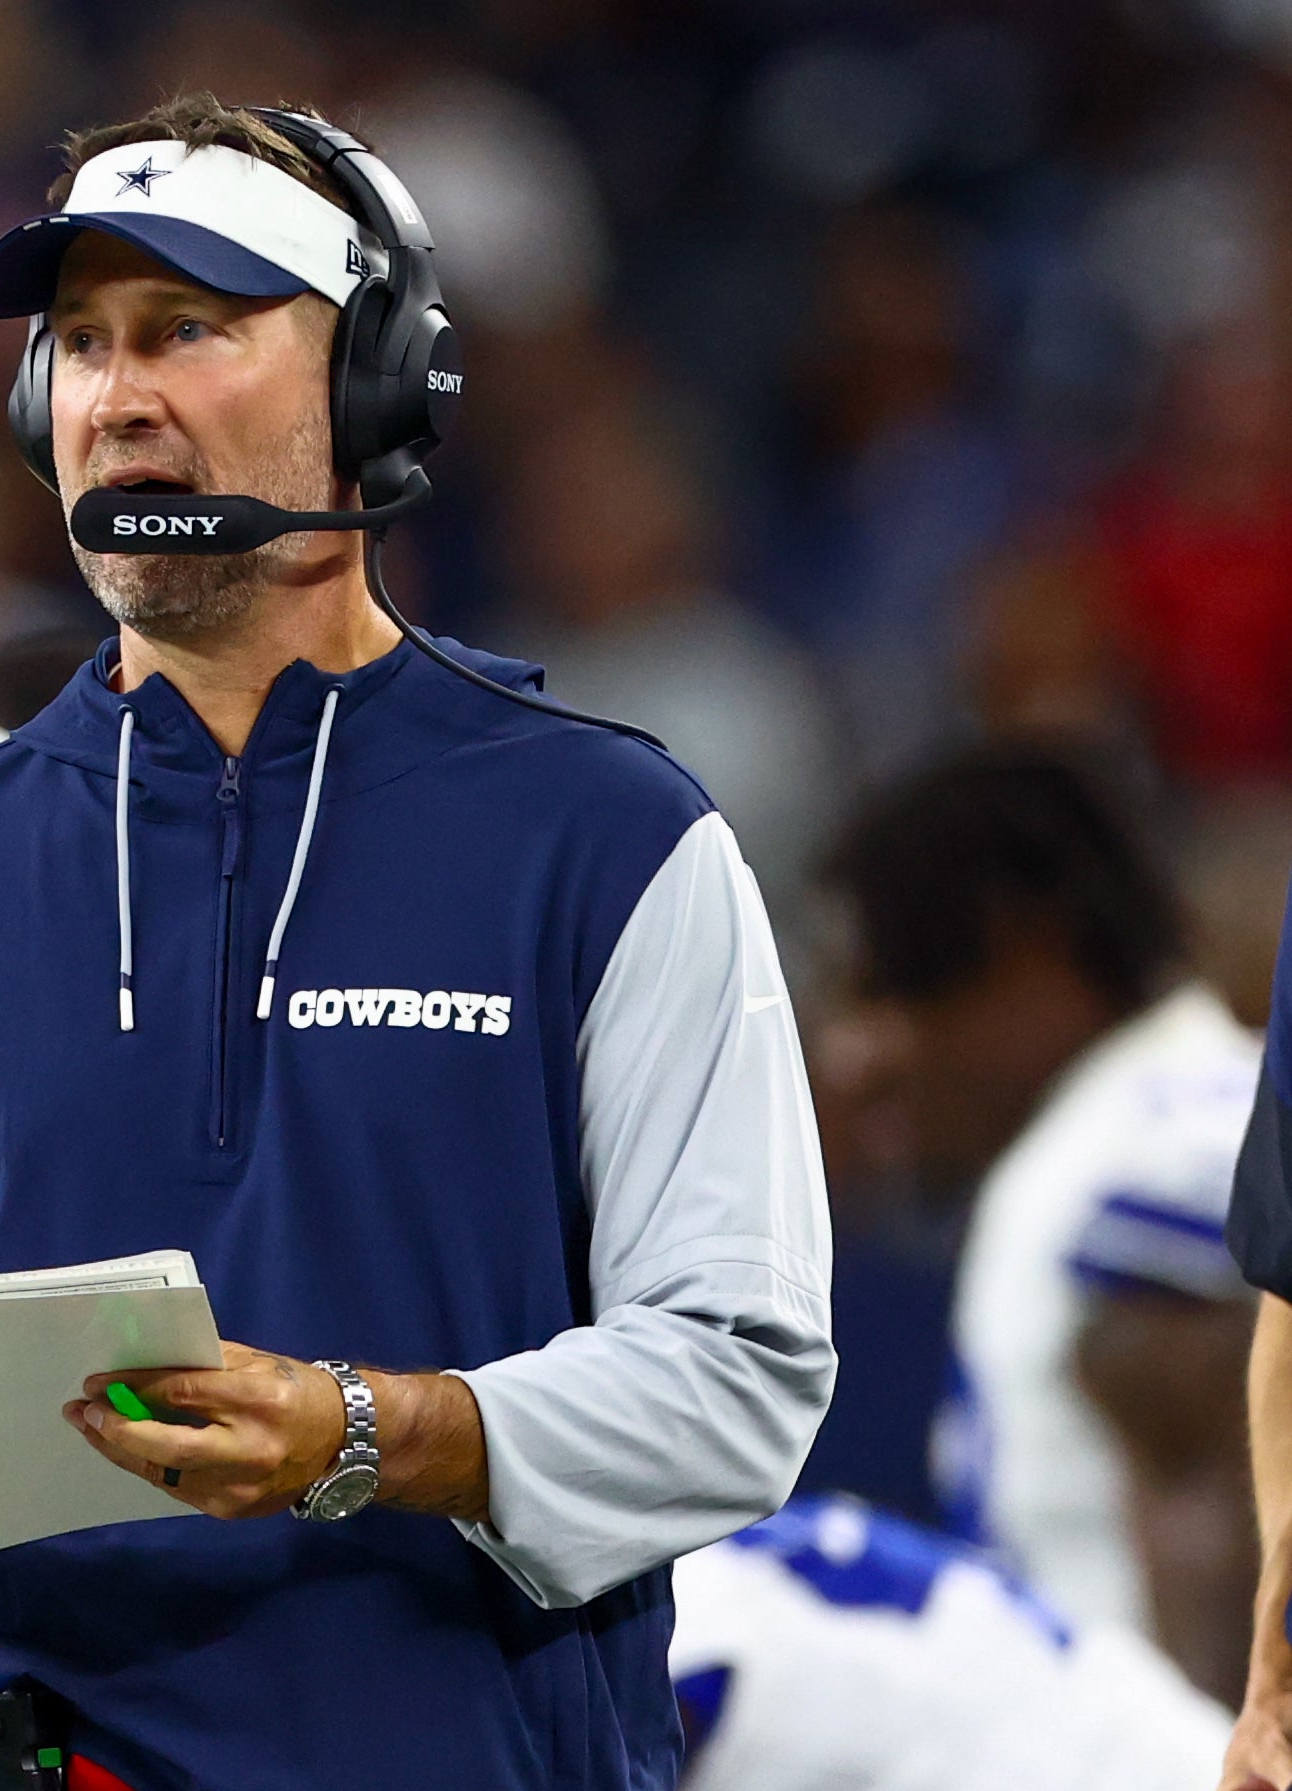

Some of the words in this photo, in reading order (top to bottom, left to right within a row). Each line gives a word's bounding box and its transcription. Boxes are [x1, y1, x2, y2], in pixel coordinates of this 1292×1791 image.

[428, 369, 463, 394] SONY
[112, 515, 223, 536] SONY
[288, 988, 512, 1036] COWBOYS
